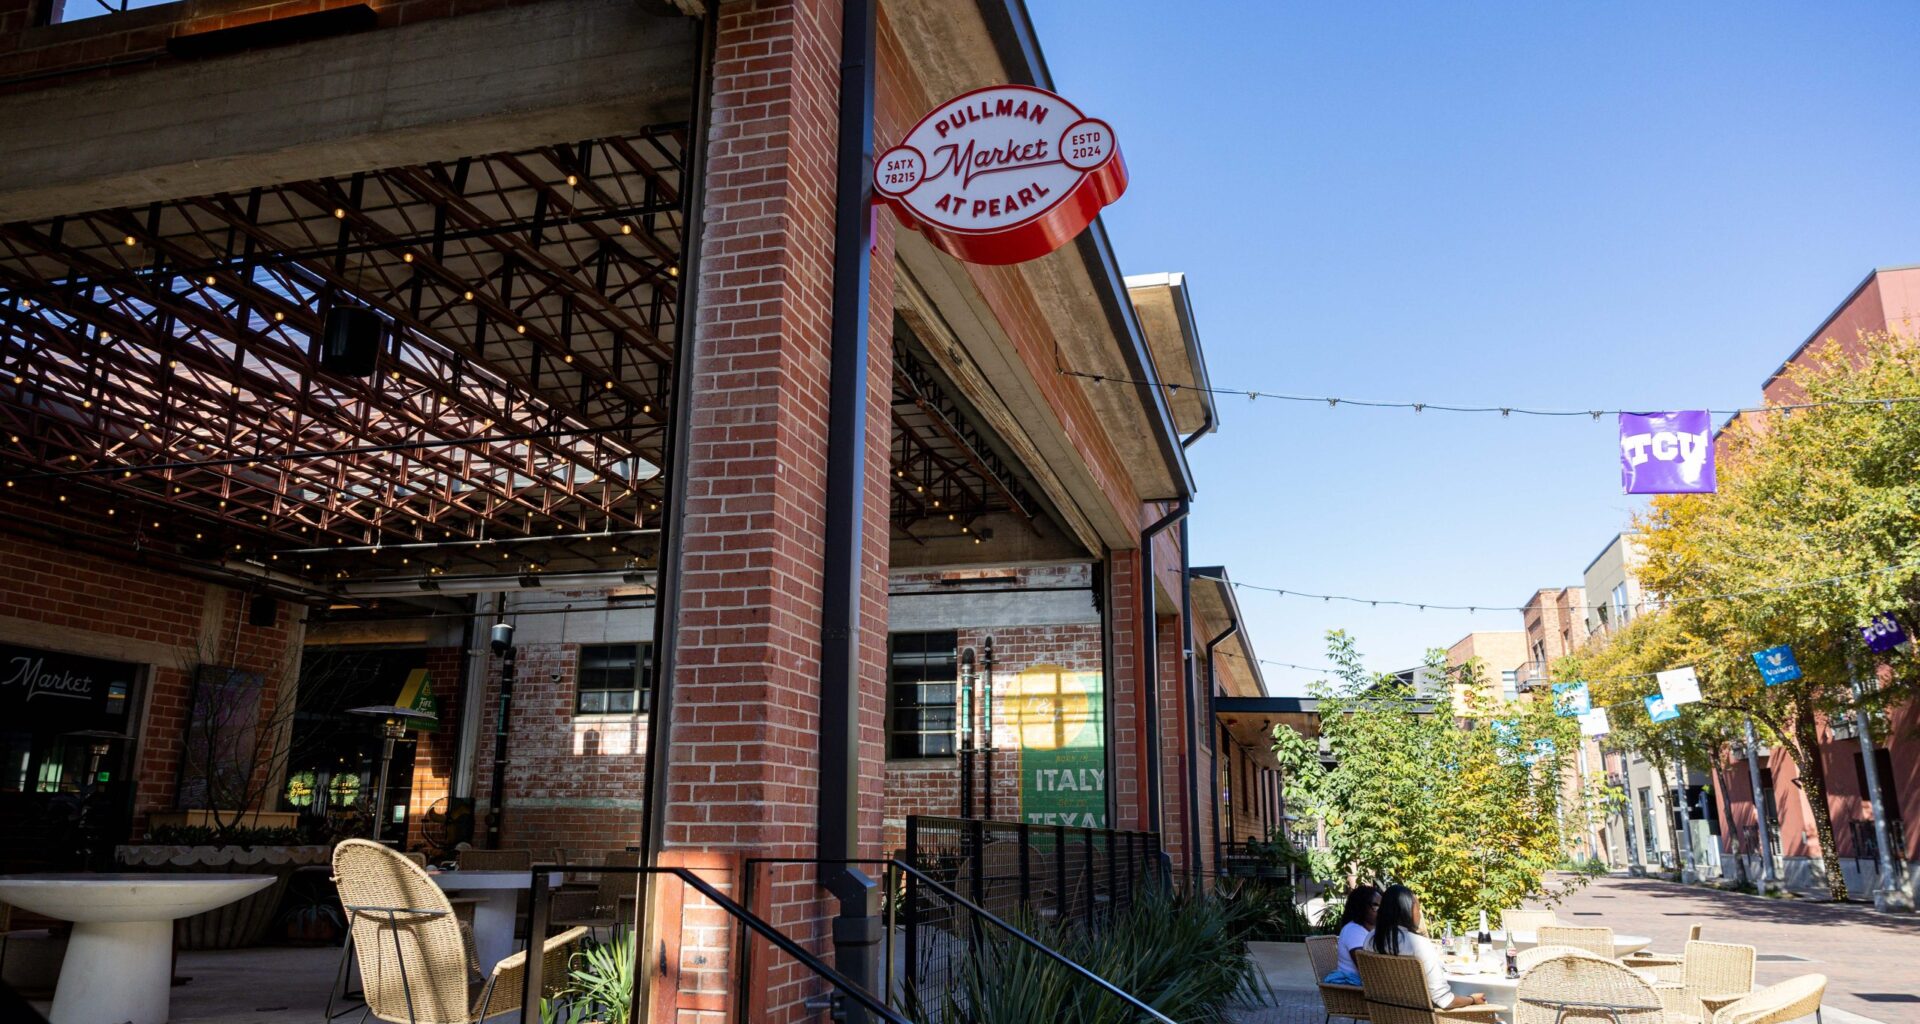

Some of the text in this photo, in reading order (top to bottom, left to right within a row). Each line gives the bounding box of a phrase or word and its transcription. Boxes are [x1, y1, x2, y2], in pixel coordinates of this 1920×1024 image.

[934, 98, 1049, 138] PULLMAN
[1072, 131, 1101, 145] ESTD
[887, 158, 914, 171] SATX
[926, 138, 1051, 190] Market
[1072, 148, 1101, 159] 2024
[884, 172, 915, 184] 78215
[935, 182, 1050, 218] AT PEARL
[1621, 429, 1709, 466] TCU
[2, 656, 92, 702] Market
[1036, 768, 1105, 792] ITALY
[1028, 812, 1106, 829] TEXA
